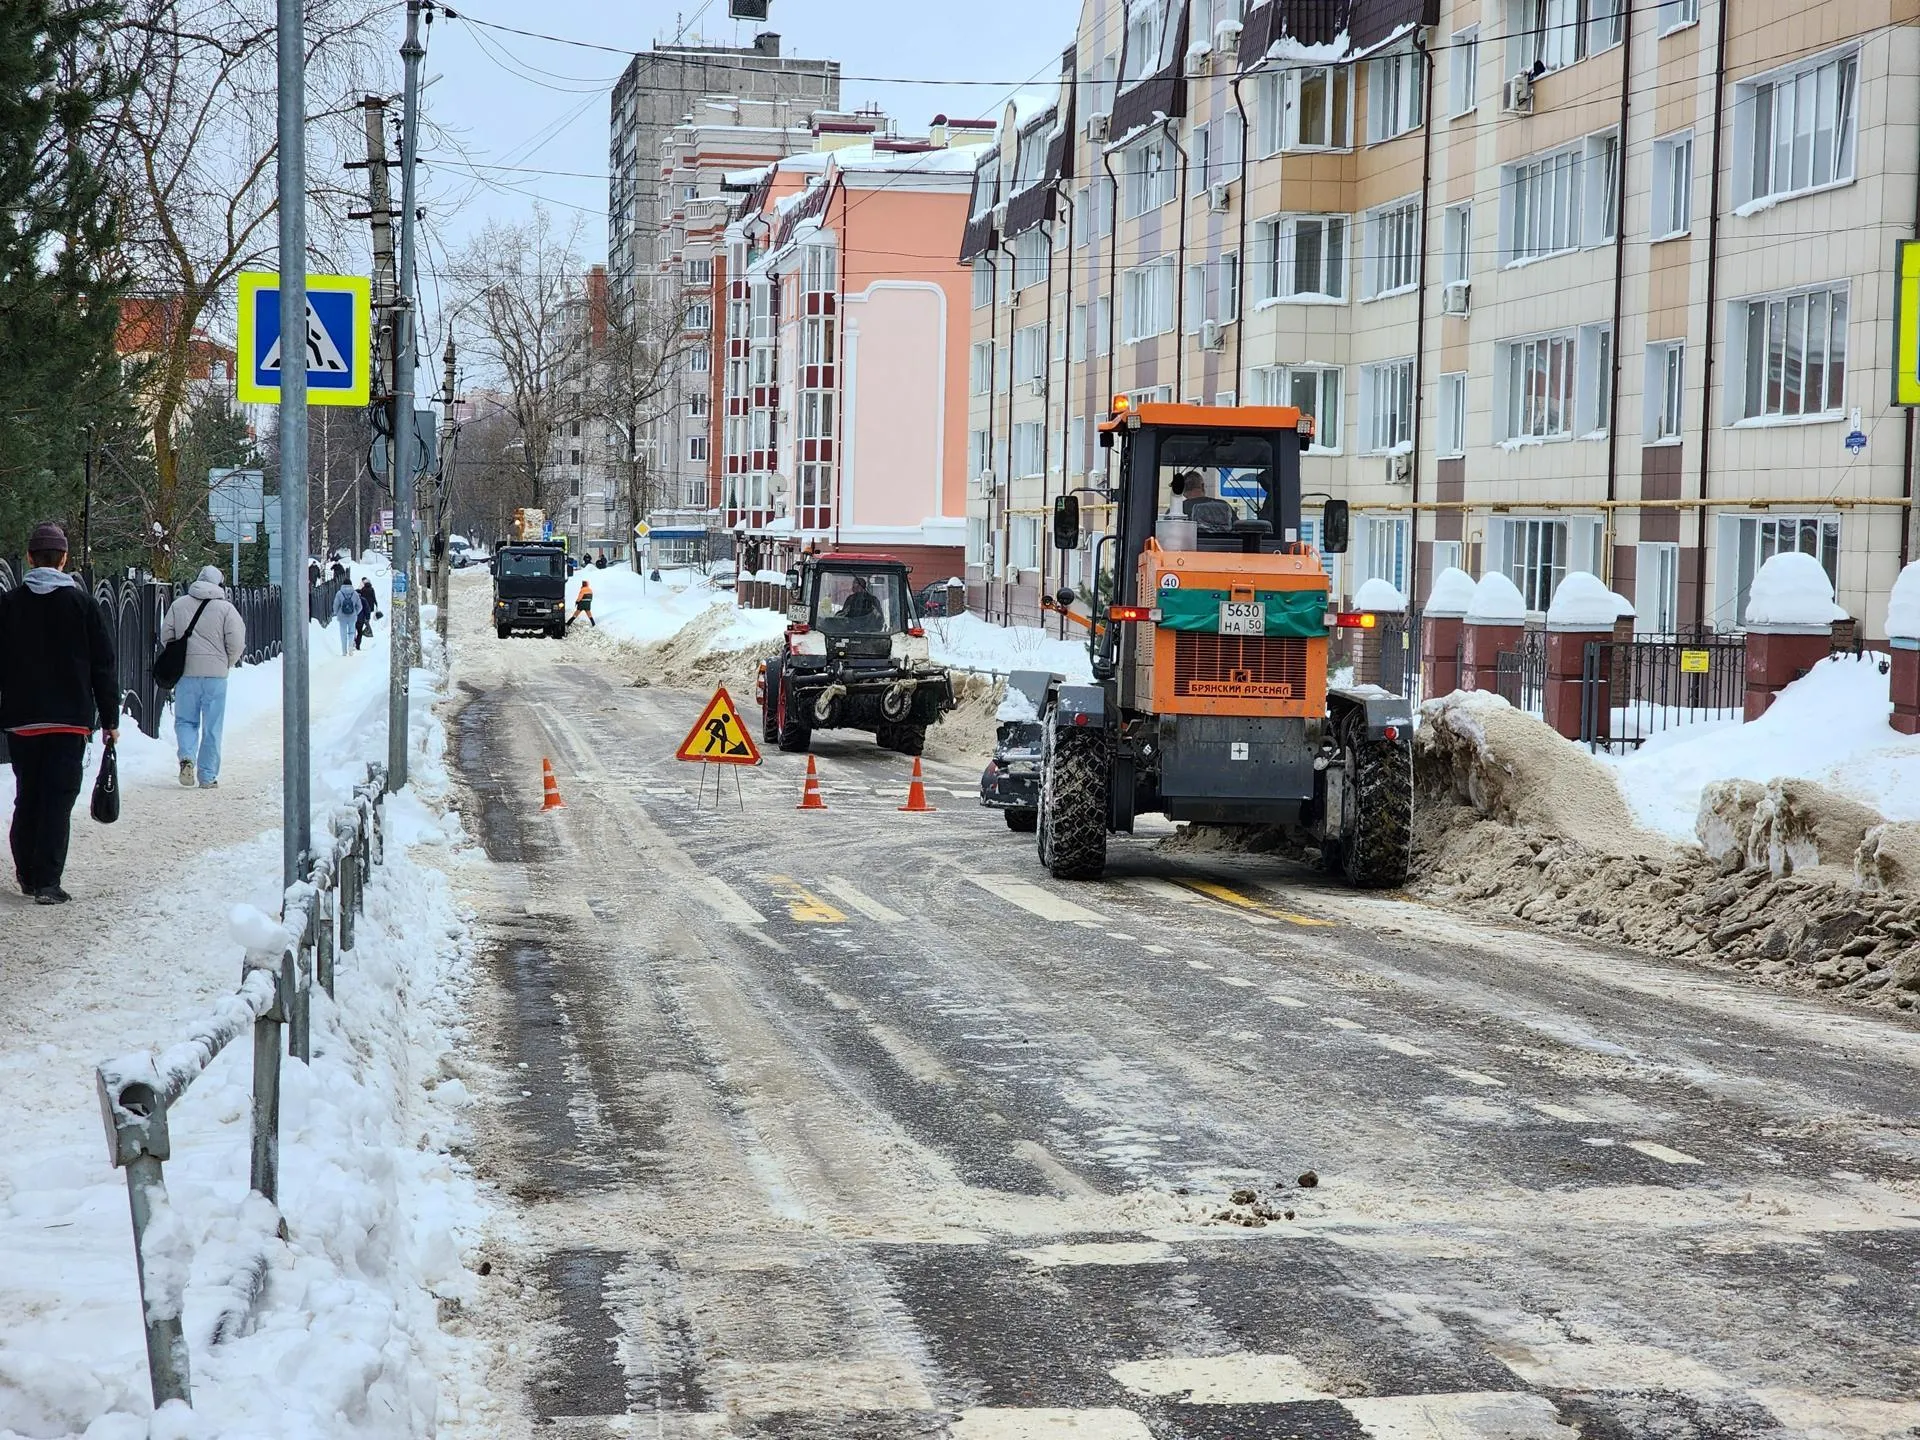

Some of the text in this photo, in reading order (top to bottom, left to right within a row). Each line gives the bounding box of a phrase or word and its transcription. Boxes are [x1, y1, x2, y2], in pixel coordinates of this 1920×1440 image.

[1164, 578, 1177, 588] 40
[1227, 603, 1260, 618] 5630
[1224, 619, 1262, 632] НА 50
[1191, 683, 1289, 695] БРЯНСКИЙ АРСЕНАЛ
